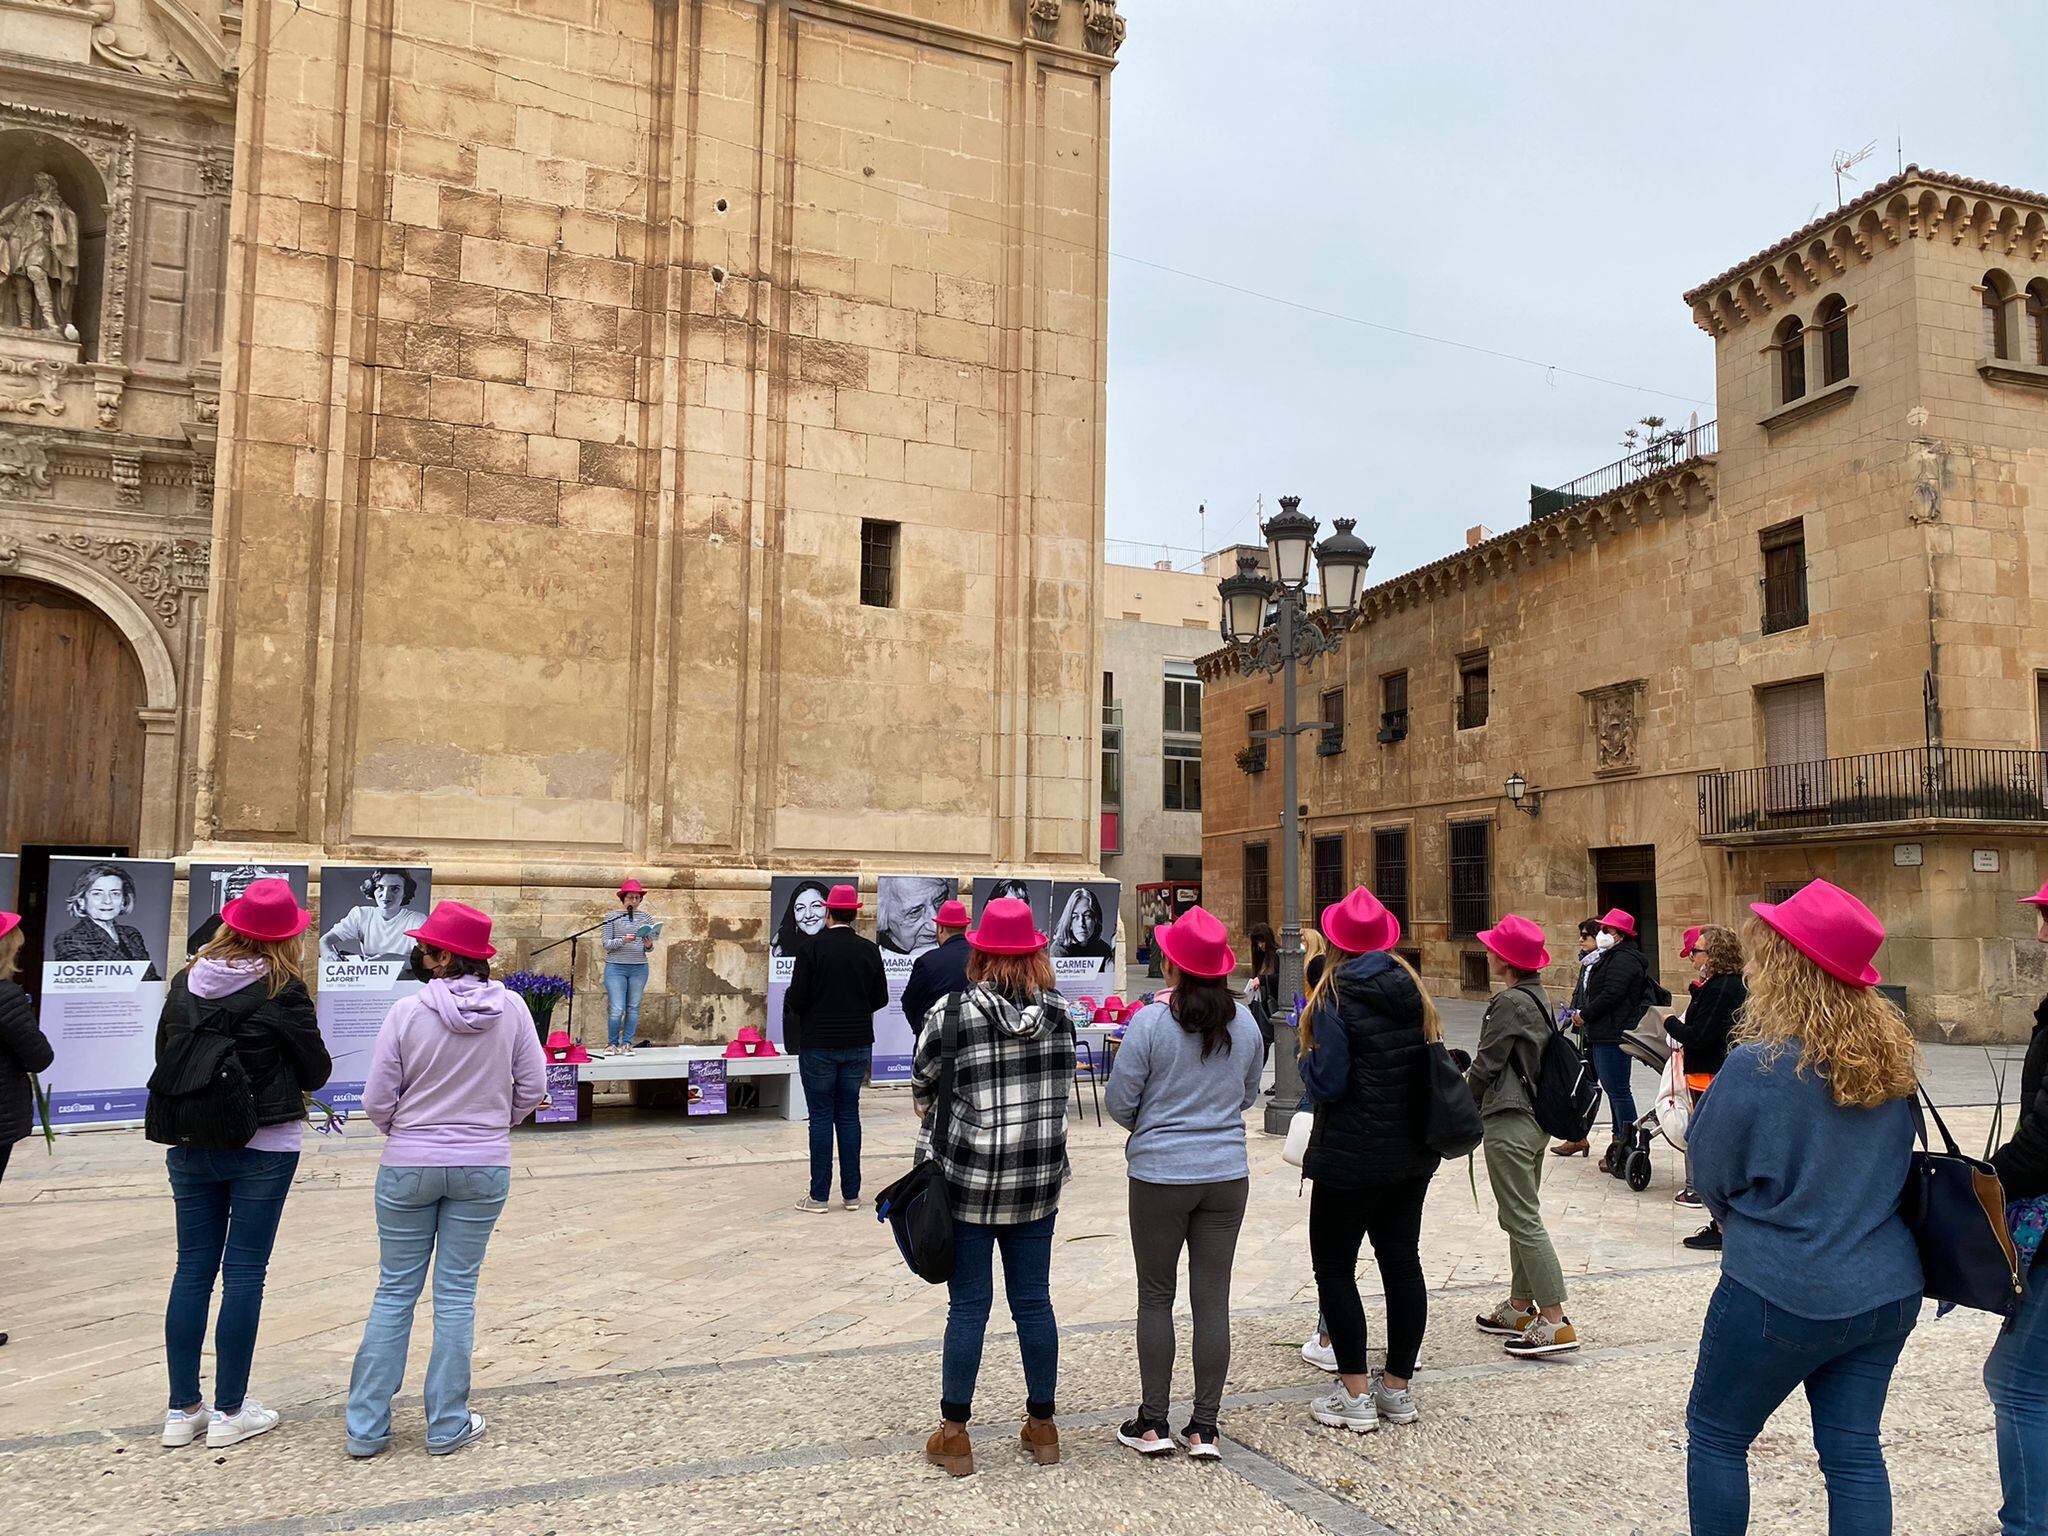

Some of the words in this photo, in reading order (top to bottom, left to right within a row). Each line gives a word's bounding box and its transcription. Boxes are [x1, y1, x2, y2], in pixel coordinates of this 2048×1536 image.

[1056, 960, 1095, 969] CARMEN
[53, 965, 133, 977] JOSEFINA
[326, 965, 389, 976] CARMEN
